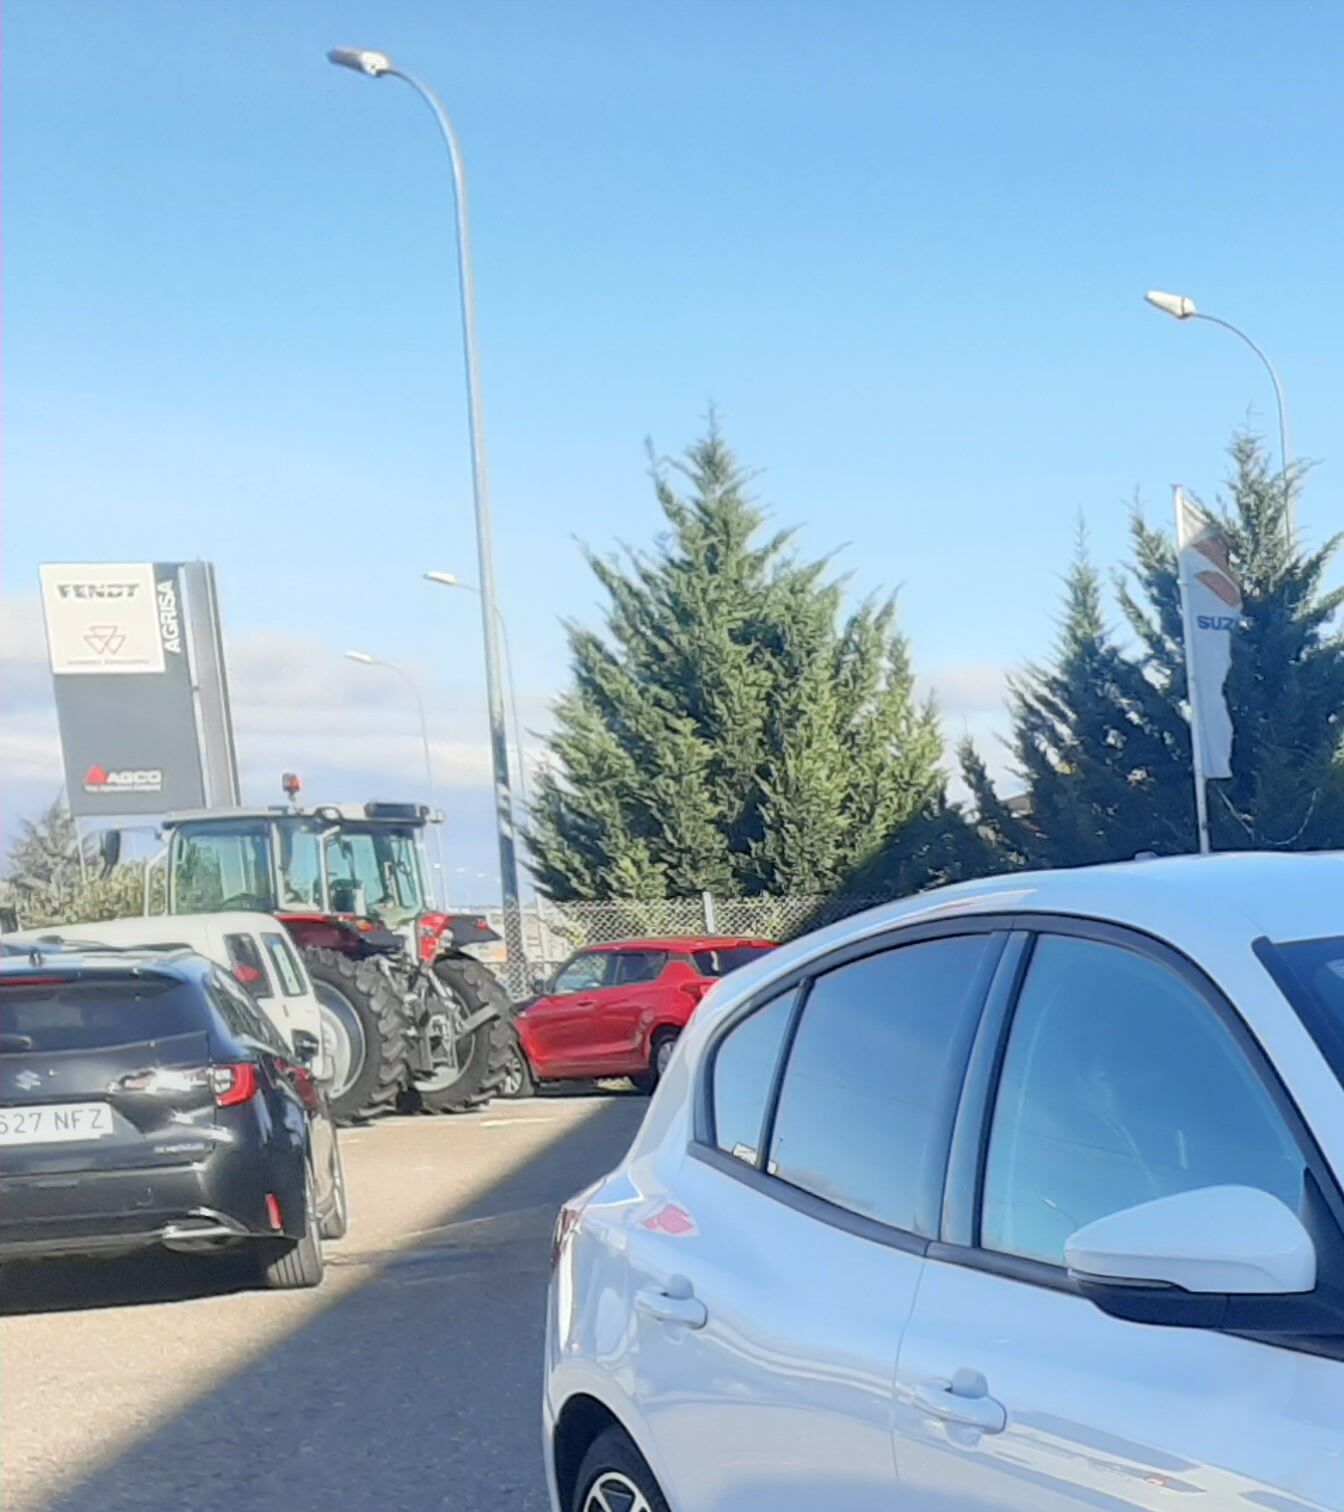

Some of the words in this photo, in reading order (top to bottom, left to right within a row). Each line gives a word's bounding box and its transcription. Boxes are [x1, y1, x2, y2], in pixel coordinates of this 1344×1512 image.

[57, 583, 140, 599] FENDT
[158, 579, 182, 653] AGRISA
[54, 1108, 104, 1131] NFZ
